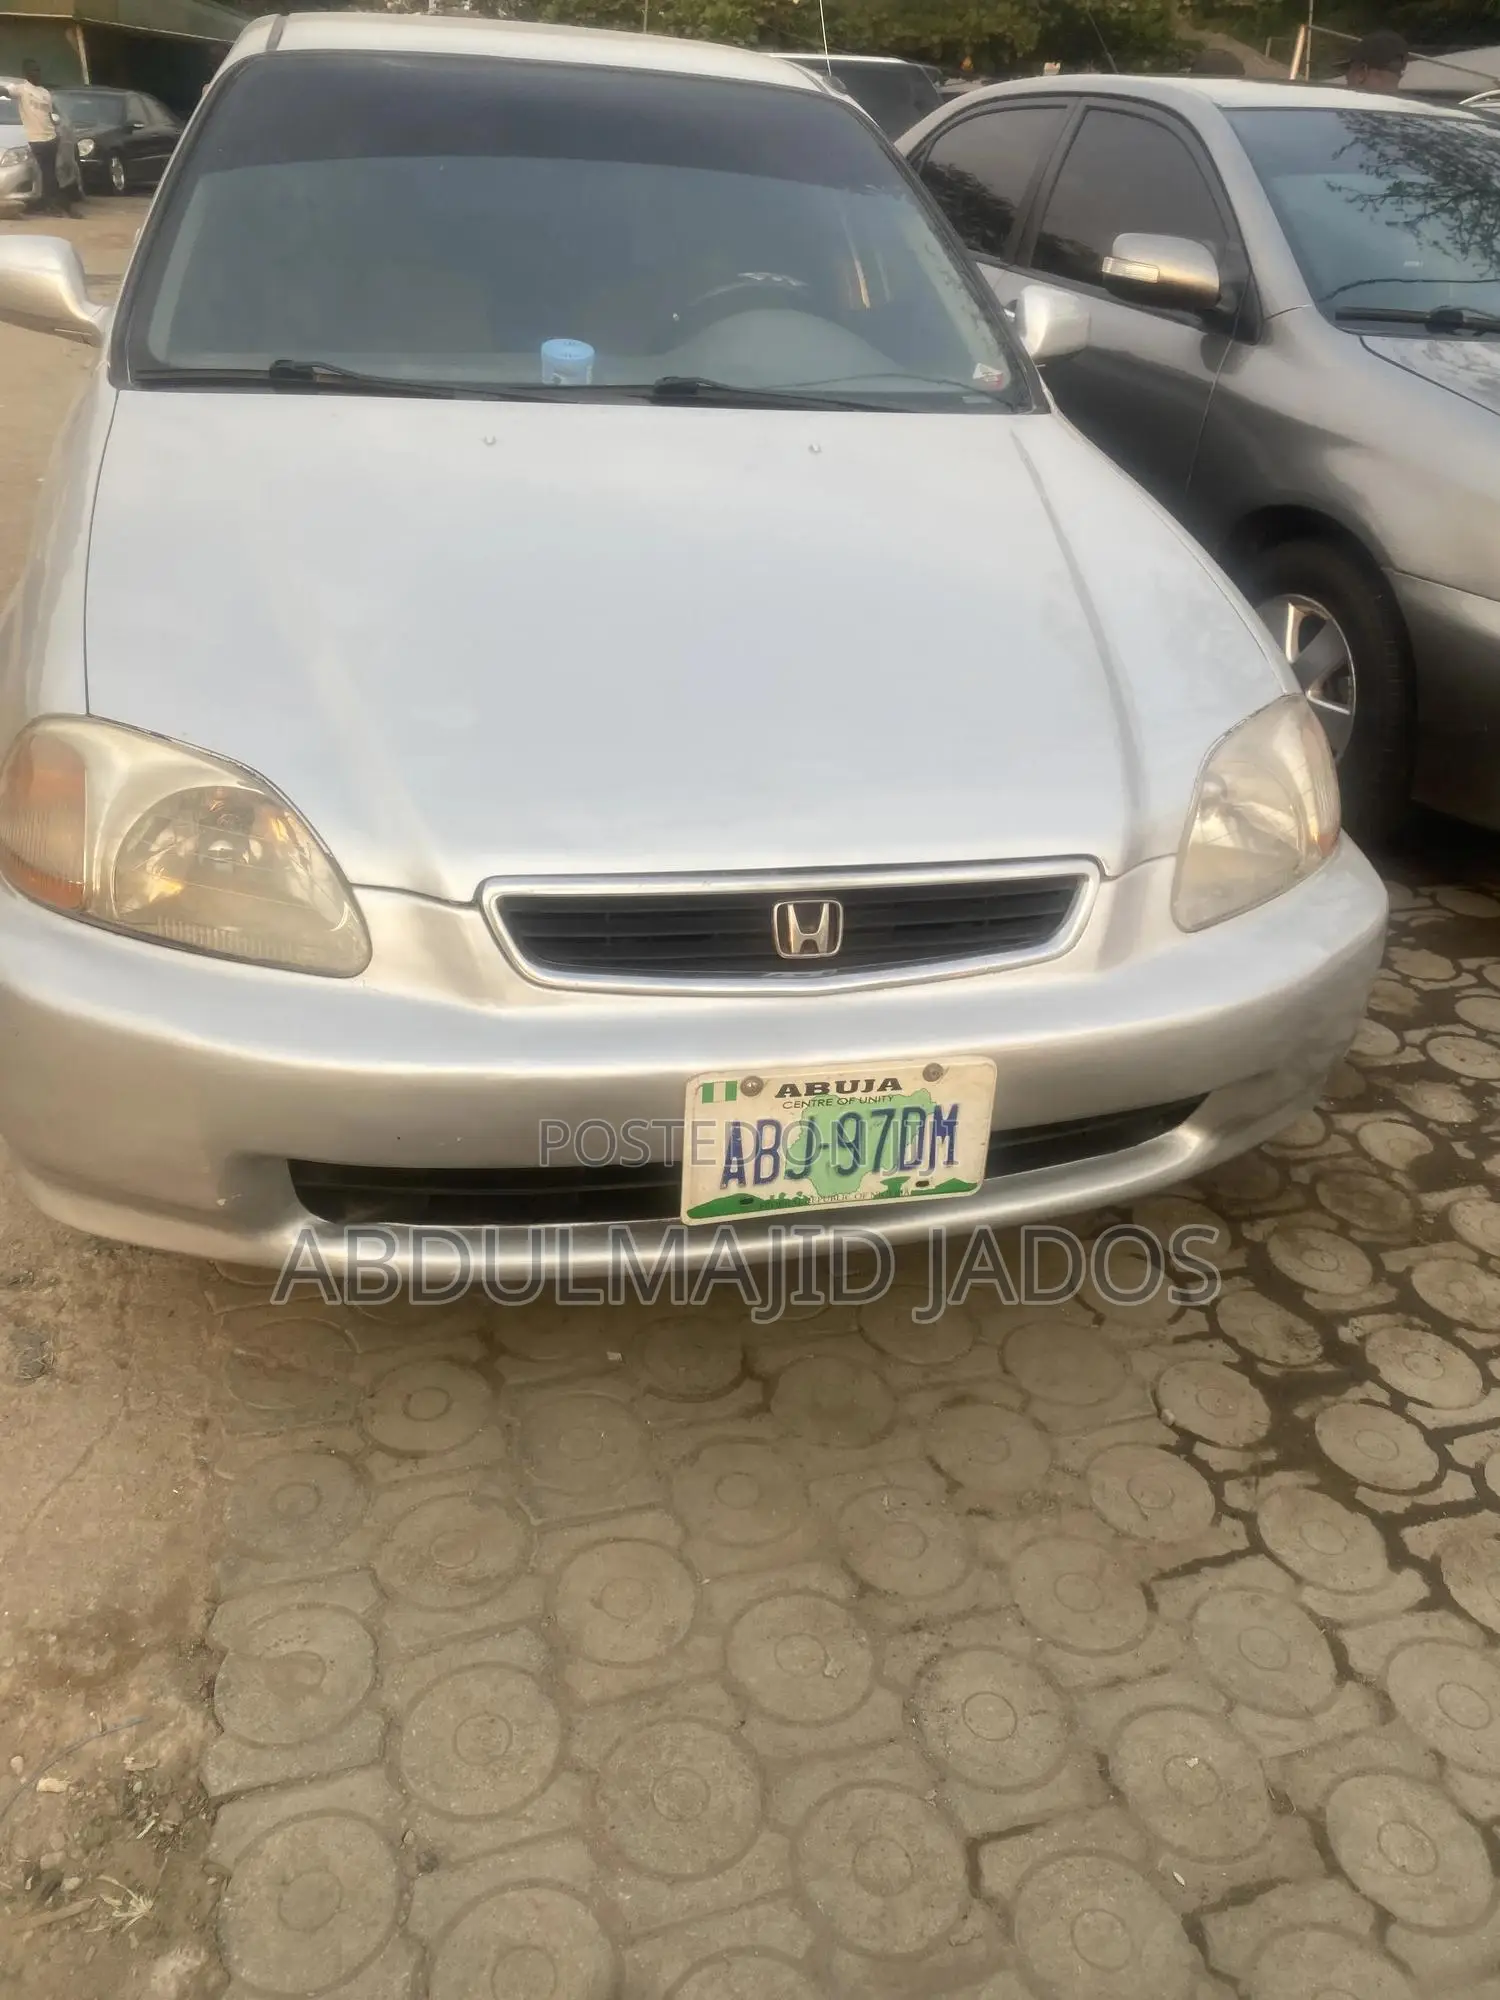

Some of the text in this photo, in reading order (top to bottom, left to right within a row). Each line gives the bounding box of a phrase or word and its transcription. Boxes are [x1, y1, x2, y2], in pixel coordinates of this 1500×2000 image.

[775, 1078, 902, 1098] ABUJA
[782, 1095, 895, 1109] CENTRE OF UNITY
[720, 1103, 960, 1189] ABJ-97DM
